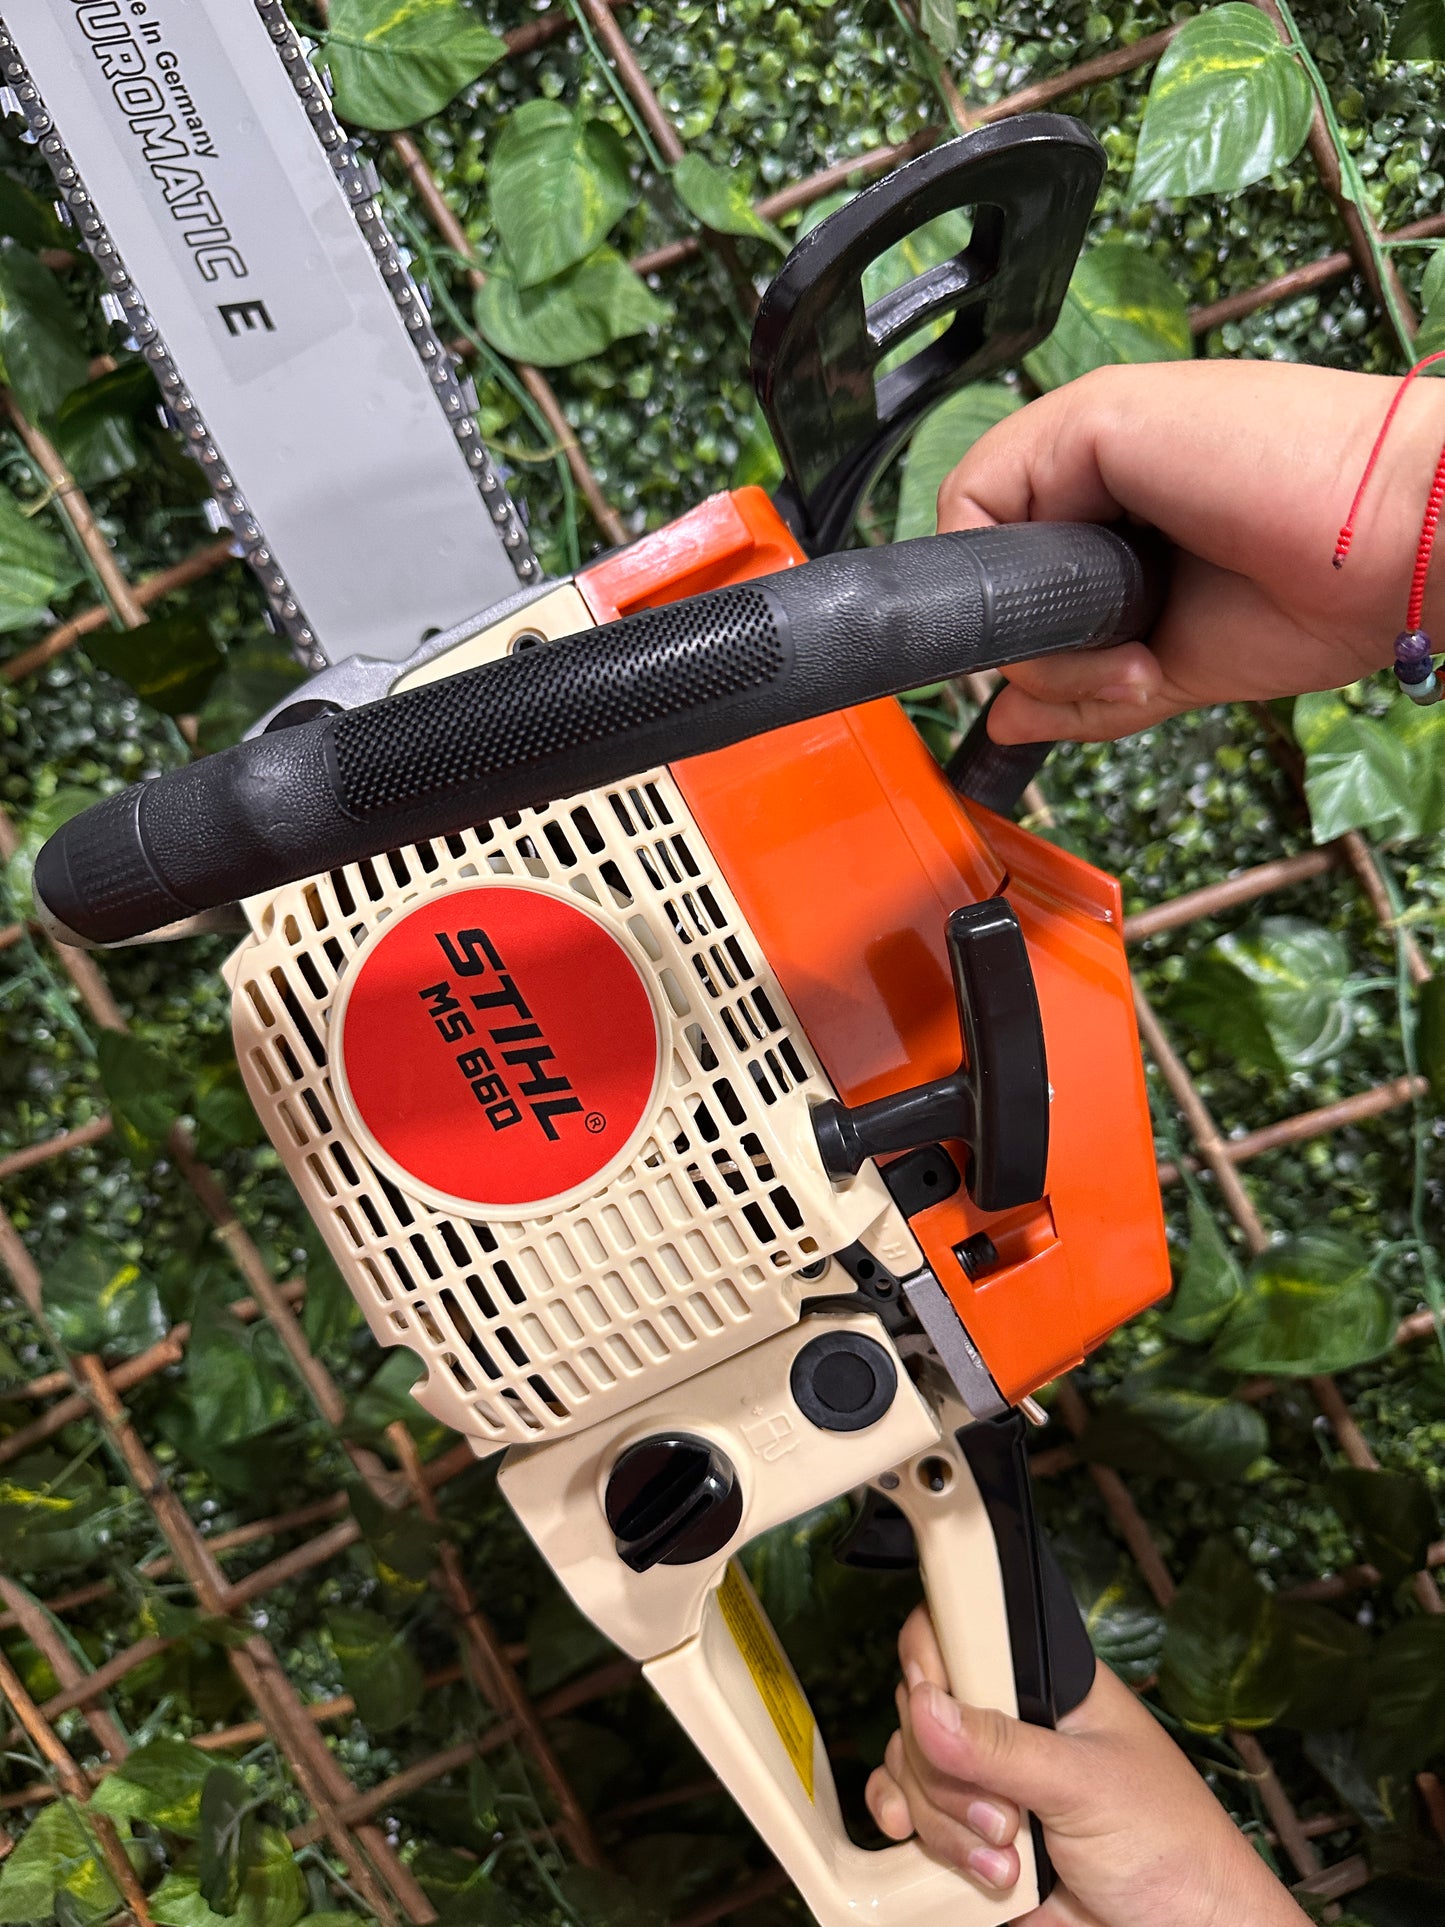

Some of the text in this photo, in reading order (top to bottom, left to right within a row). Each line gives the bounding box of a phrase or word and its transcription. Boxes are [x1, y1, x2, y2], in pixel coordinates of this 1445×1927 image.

[139, 21, 161, 44] In
[155, 51, 219, 158] Germany
[70, 0, 277, 336] UROMATIC E
[418, 981, 523, 1131] MS 660
